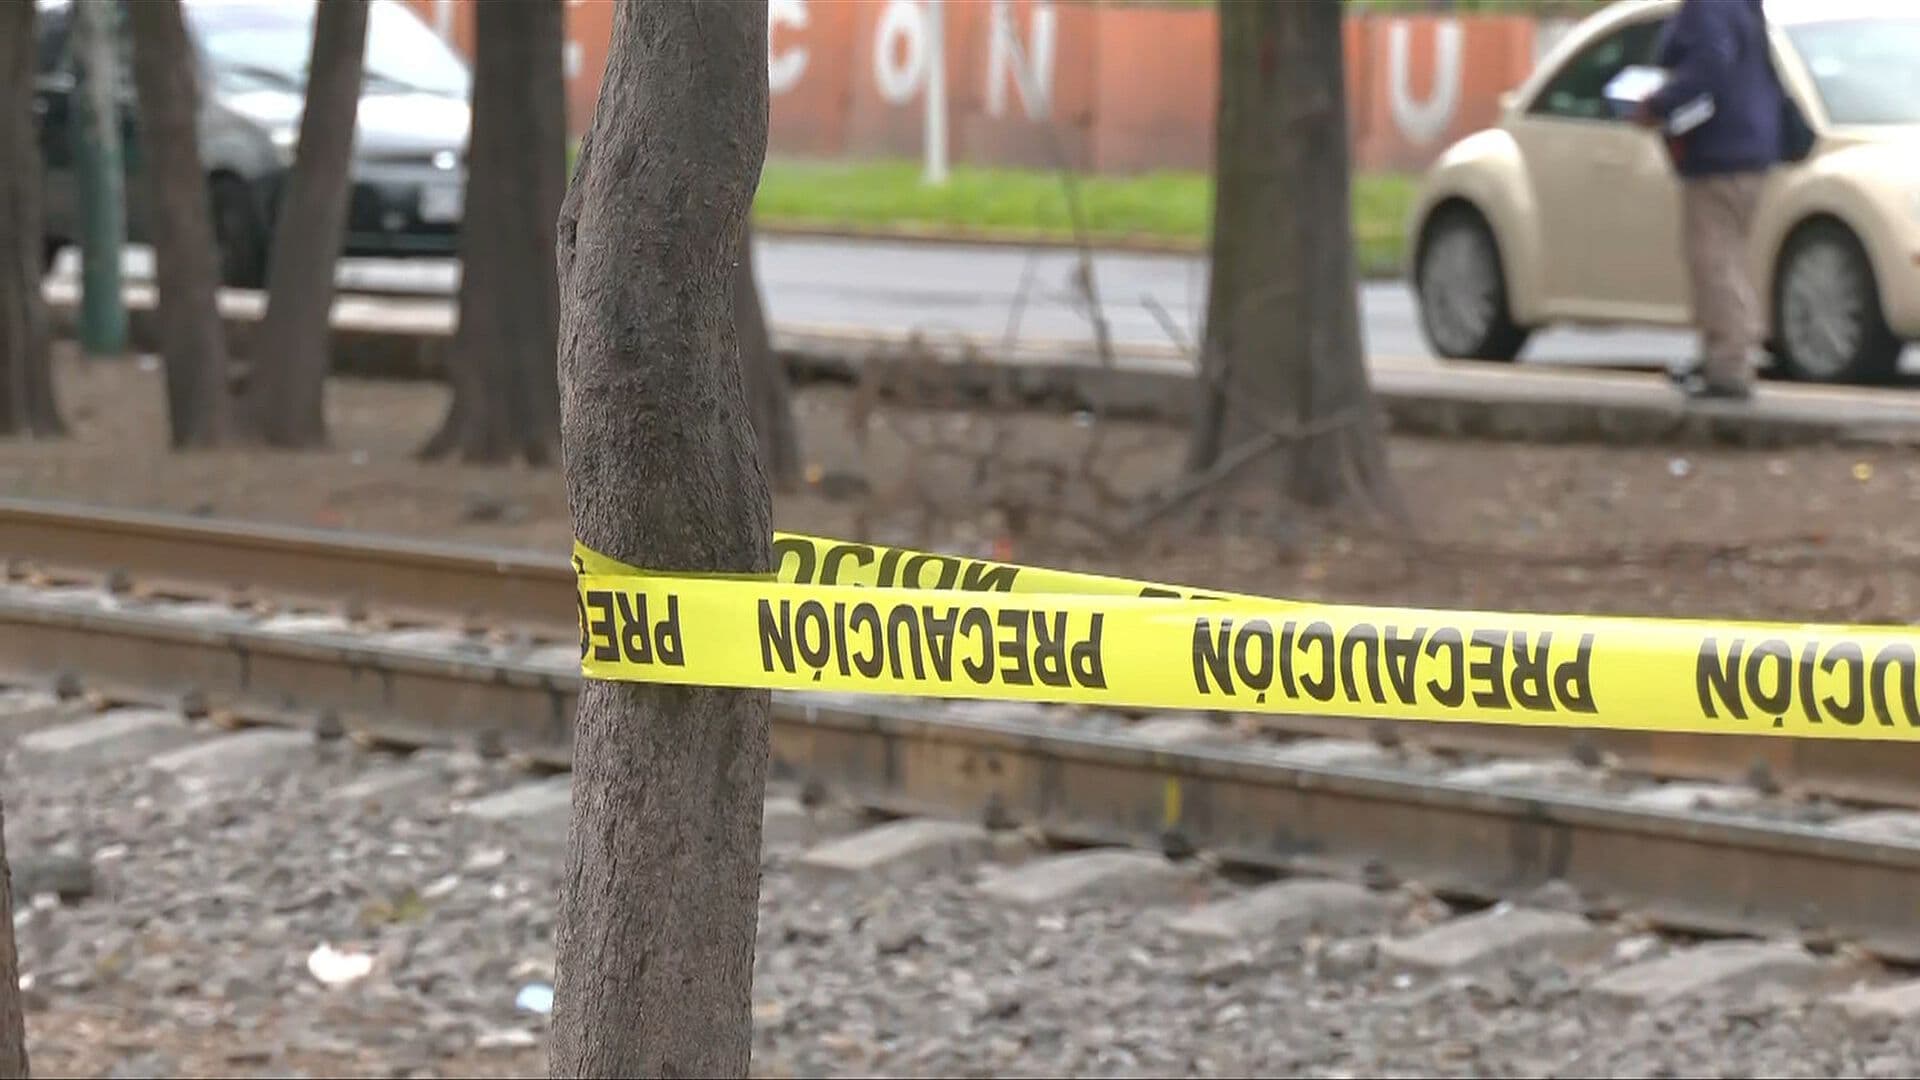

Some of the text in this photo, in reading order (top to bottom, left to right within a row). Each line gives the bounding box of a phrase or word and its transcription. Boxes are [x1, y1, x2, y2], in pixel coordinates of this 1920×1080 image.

[577, 590, 1920, 728] UCIÓN PRECAUCIÓN PRECAUCIÓN PRE
